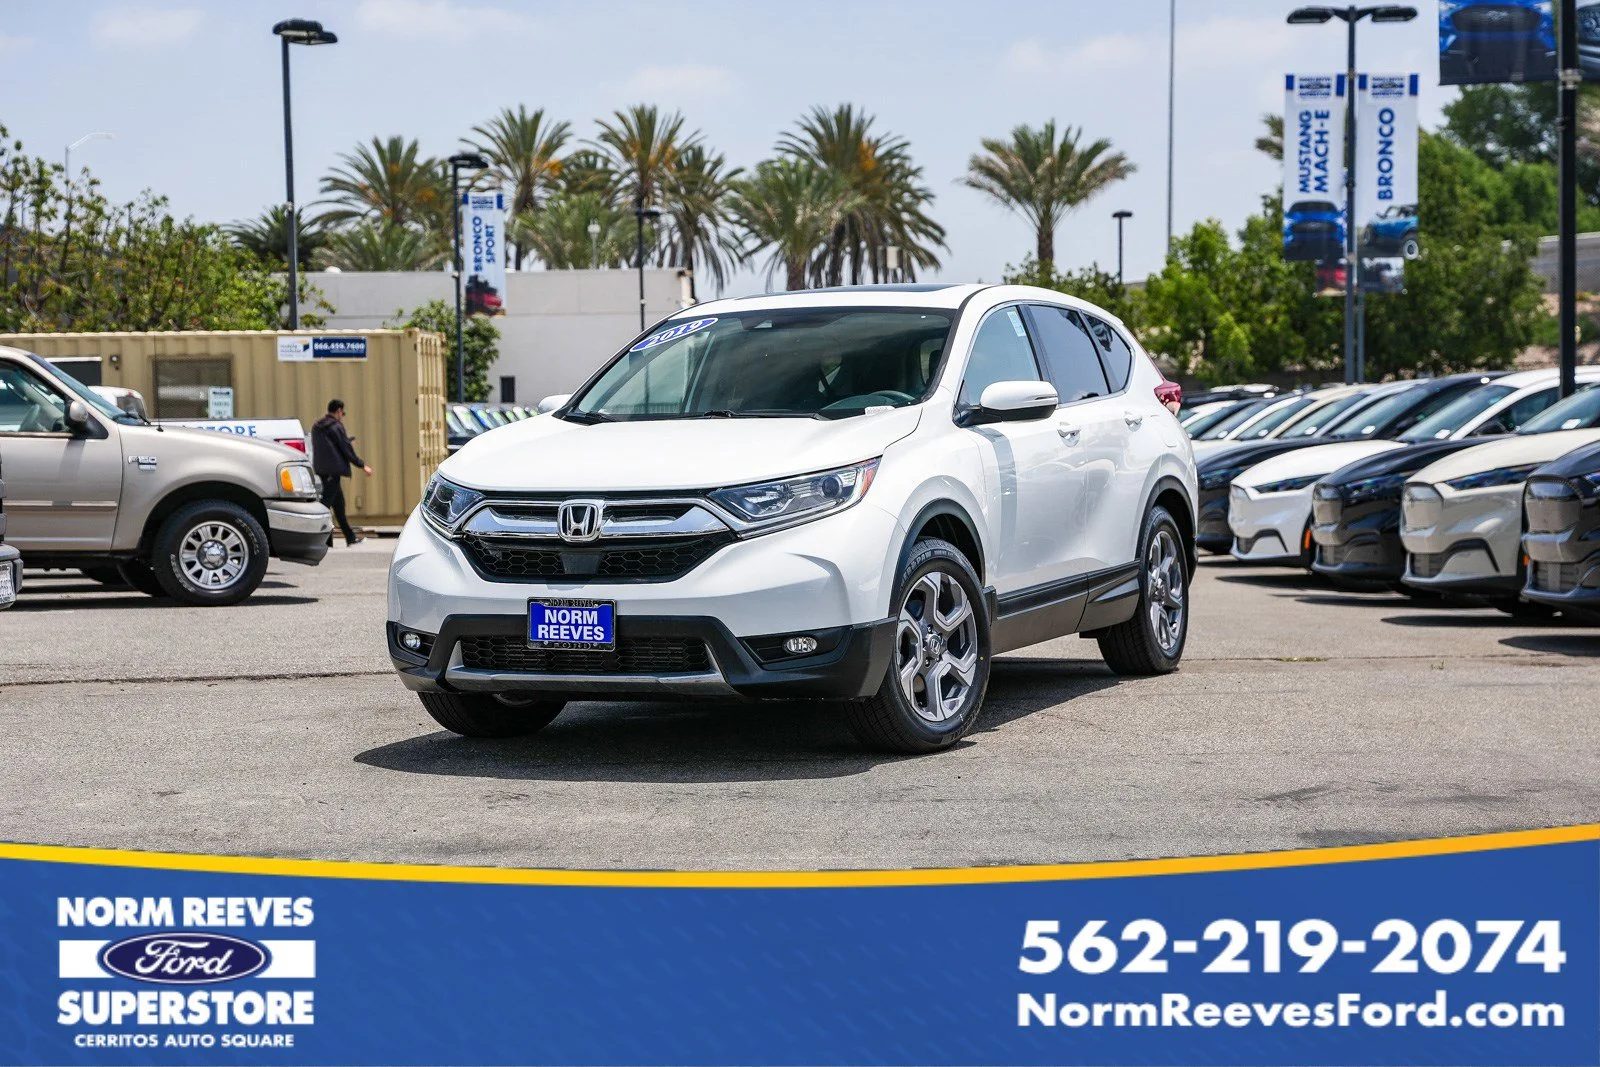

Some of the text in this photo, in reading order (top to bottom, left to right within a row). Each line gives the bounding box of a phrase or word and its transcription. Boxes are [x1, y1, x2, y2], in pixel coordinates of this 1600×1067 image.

[1299, 109, 1312, 193] MUSTANG
[1314, 109, 1330, 193] MACH-E
[1377, 107, 1395, 200] BRONCO
[472, 216, 483, 272] BRONCO
[485, 224, 496, 263] SPORT
[645, 320, 703, 349] 2019
[537, 624, 605, 641] REEVES
[544, 609, 598, 625] NORM
